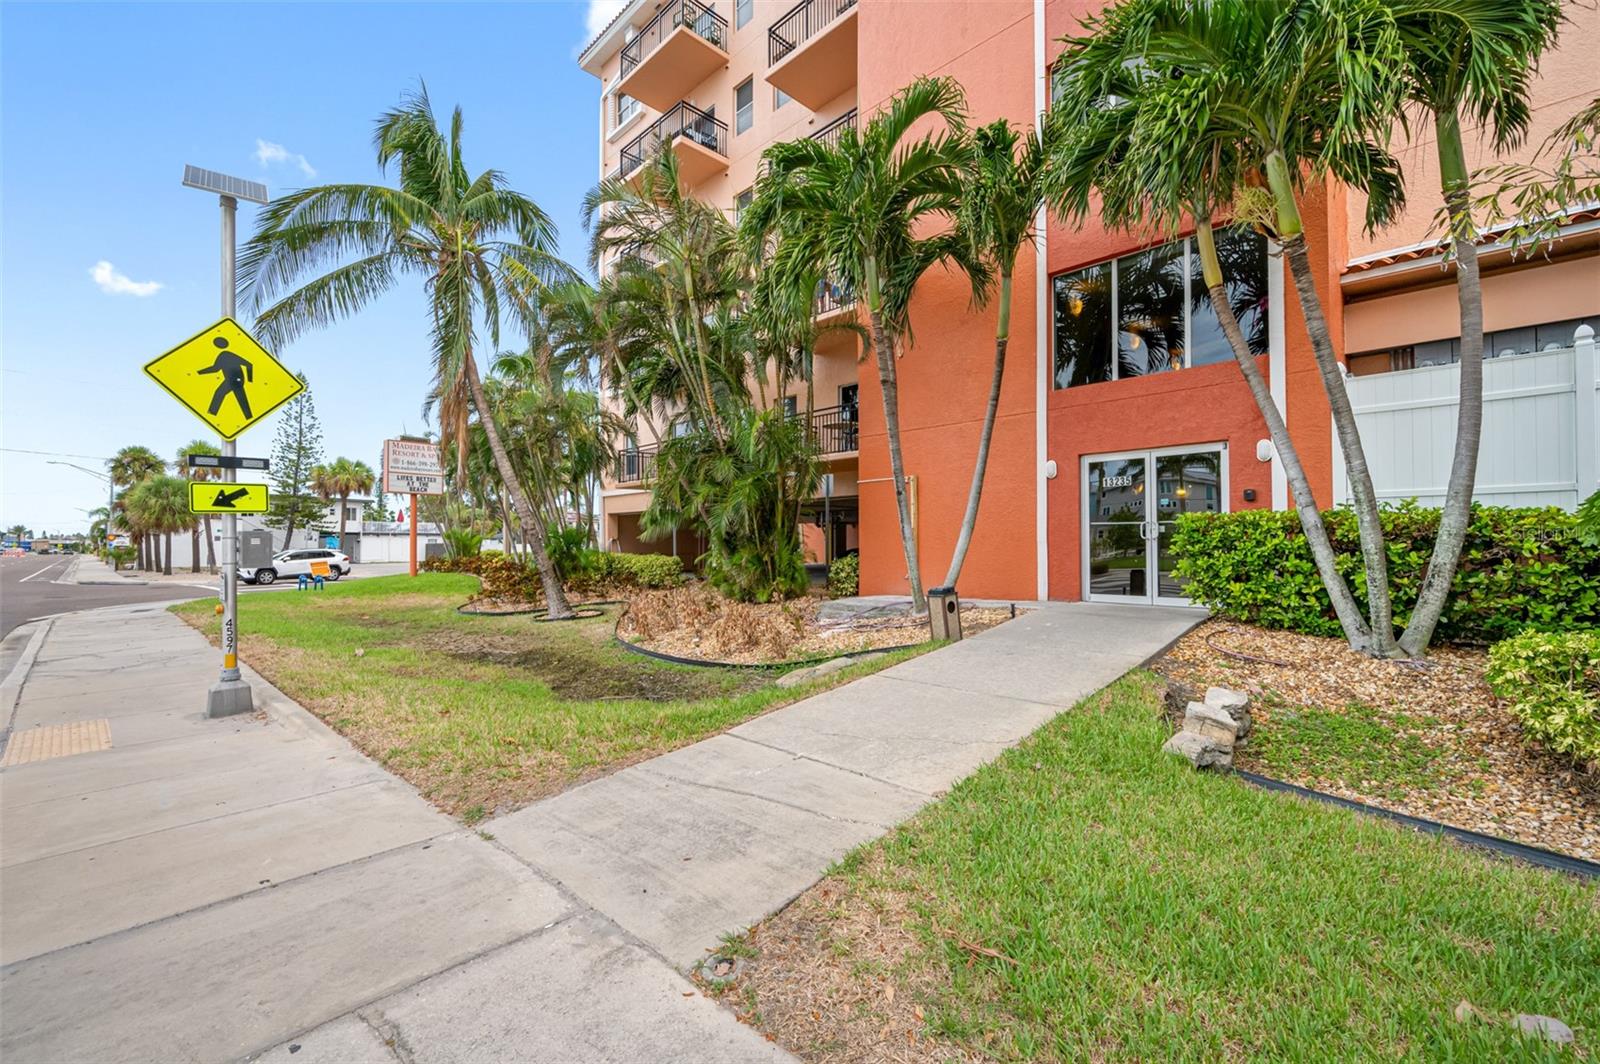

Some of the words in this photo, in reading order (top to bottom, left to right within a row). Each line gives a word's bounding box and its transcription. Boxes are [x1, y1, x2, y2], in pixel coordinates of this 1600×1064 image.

[392, 442, 425, 451] MADEIRA
[392, 449, 419, 458] RESORT
[1103, 476, 1131, 487] 13235
[225, 619, 234, 654] 4597
